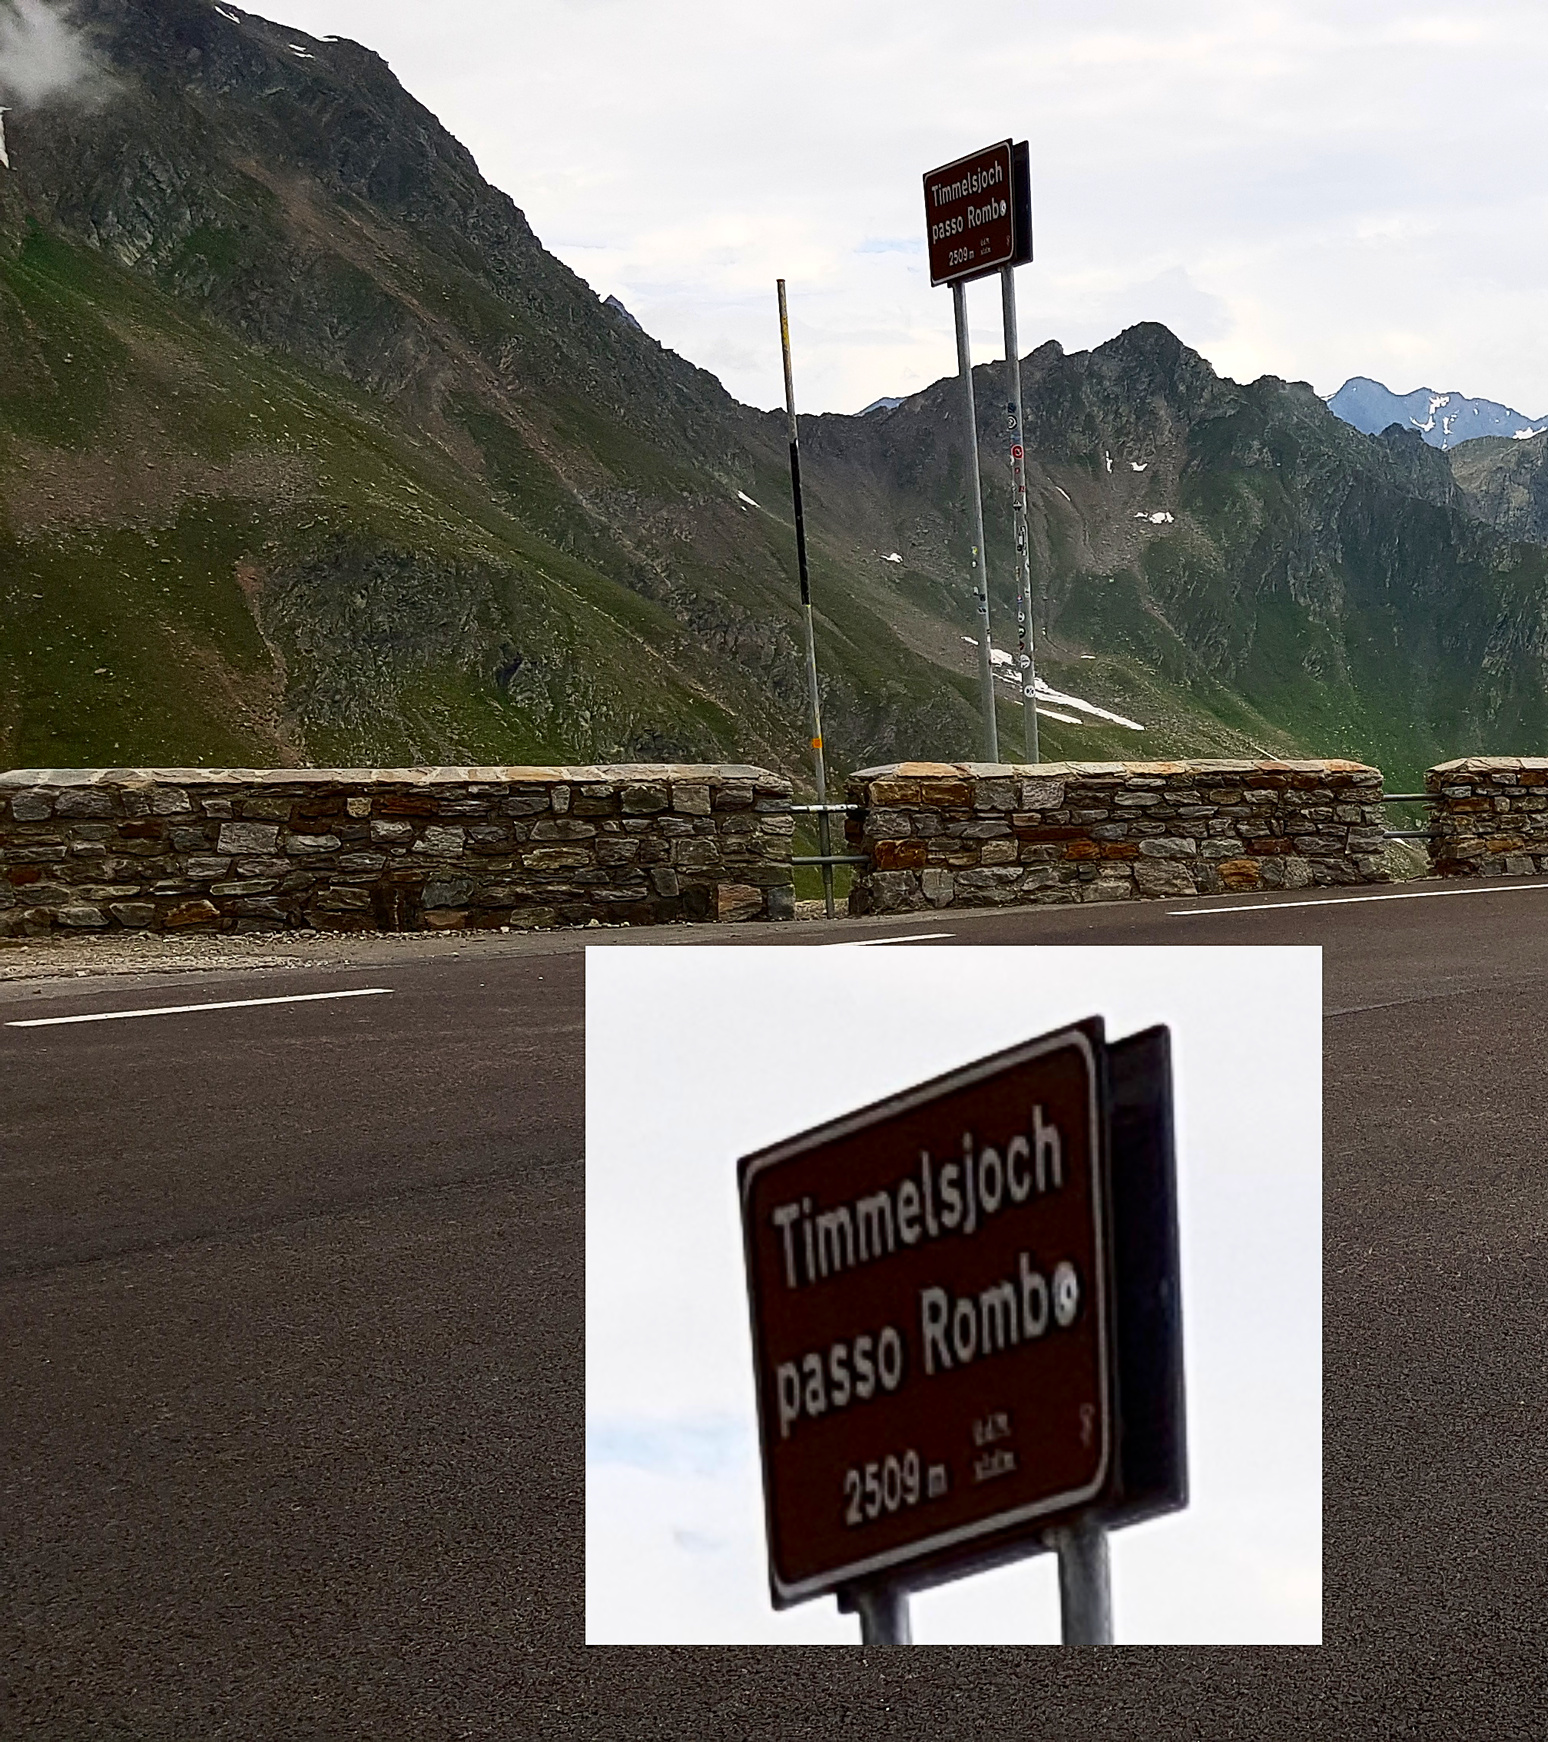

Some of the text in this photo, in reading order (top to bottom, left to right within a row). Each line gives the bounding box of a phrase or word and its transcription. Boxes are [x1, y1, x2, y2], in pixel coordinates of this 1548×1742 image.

[931, 160, 1002, 207] Timmelsjoch
[932, 198, 1007, 245] passo Rombo
[948, 247, 968, 266] 2509
[968, 250, 975, 259] m
[772, 1104, 1063, 1289] Timmelsjoch
[776, 1251, 1079, 1440] passo Rombo
[844, 1449, 921, 1526] 2509
[927, 1463, 947, 1498] m
